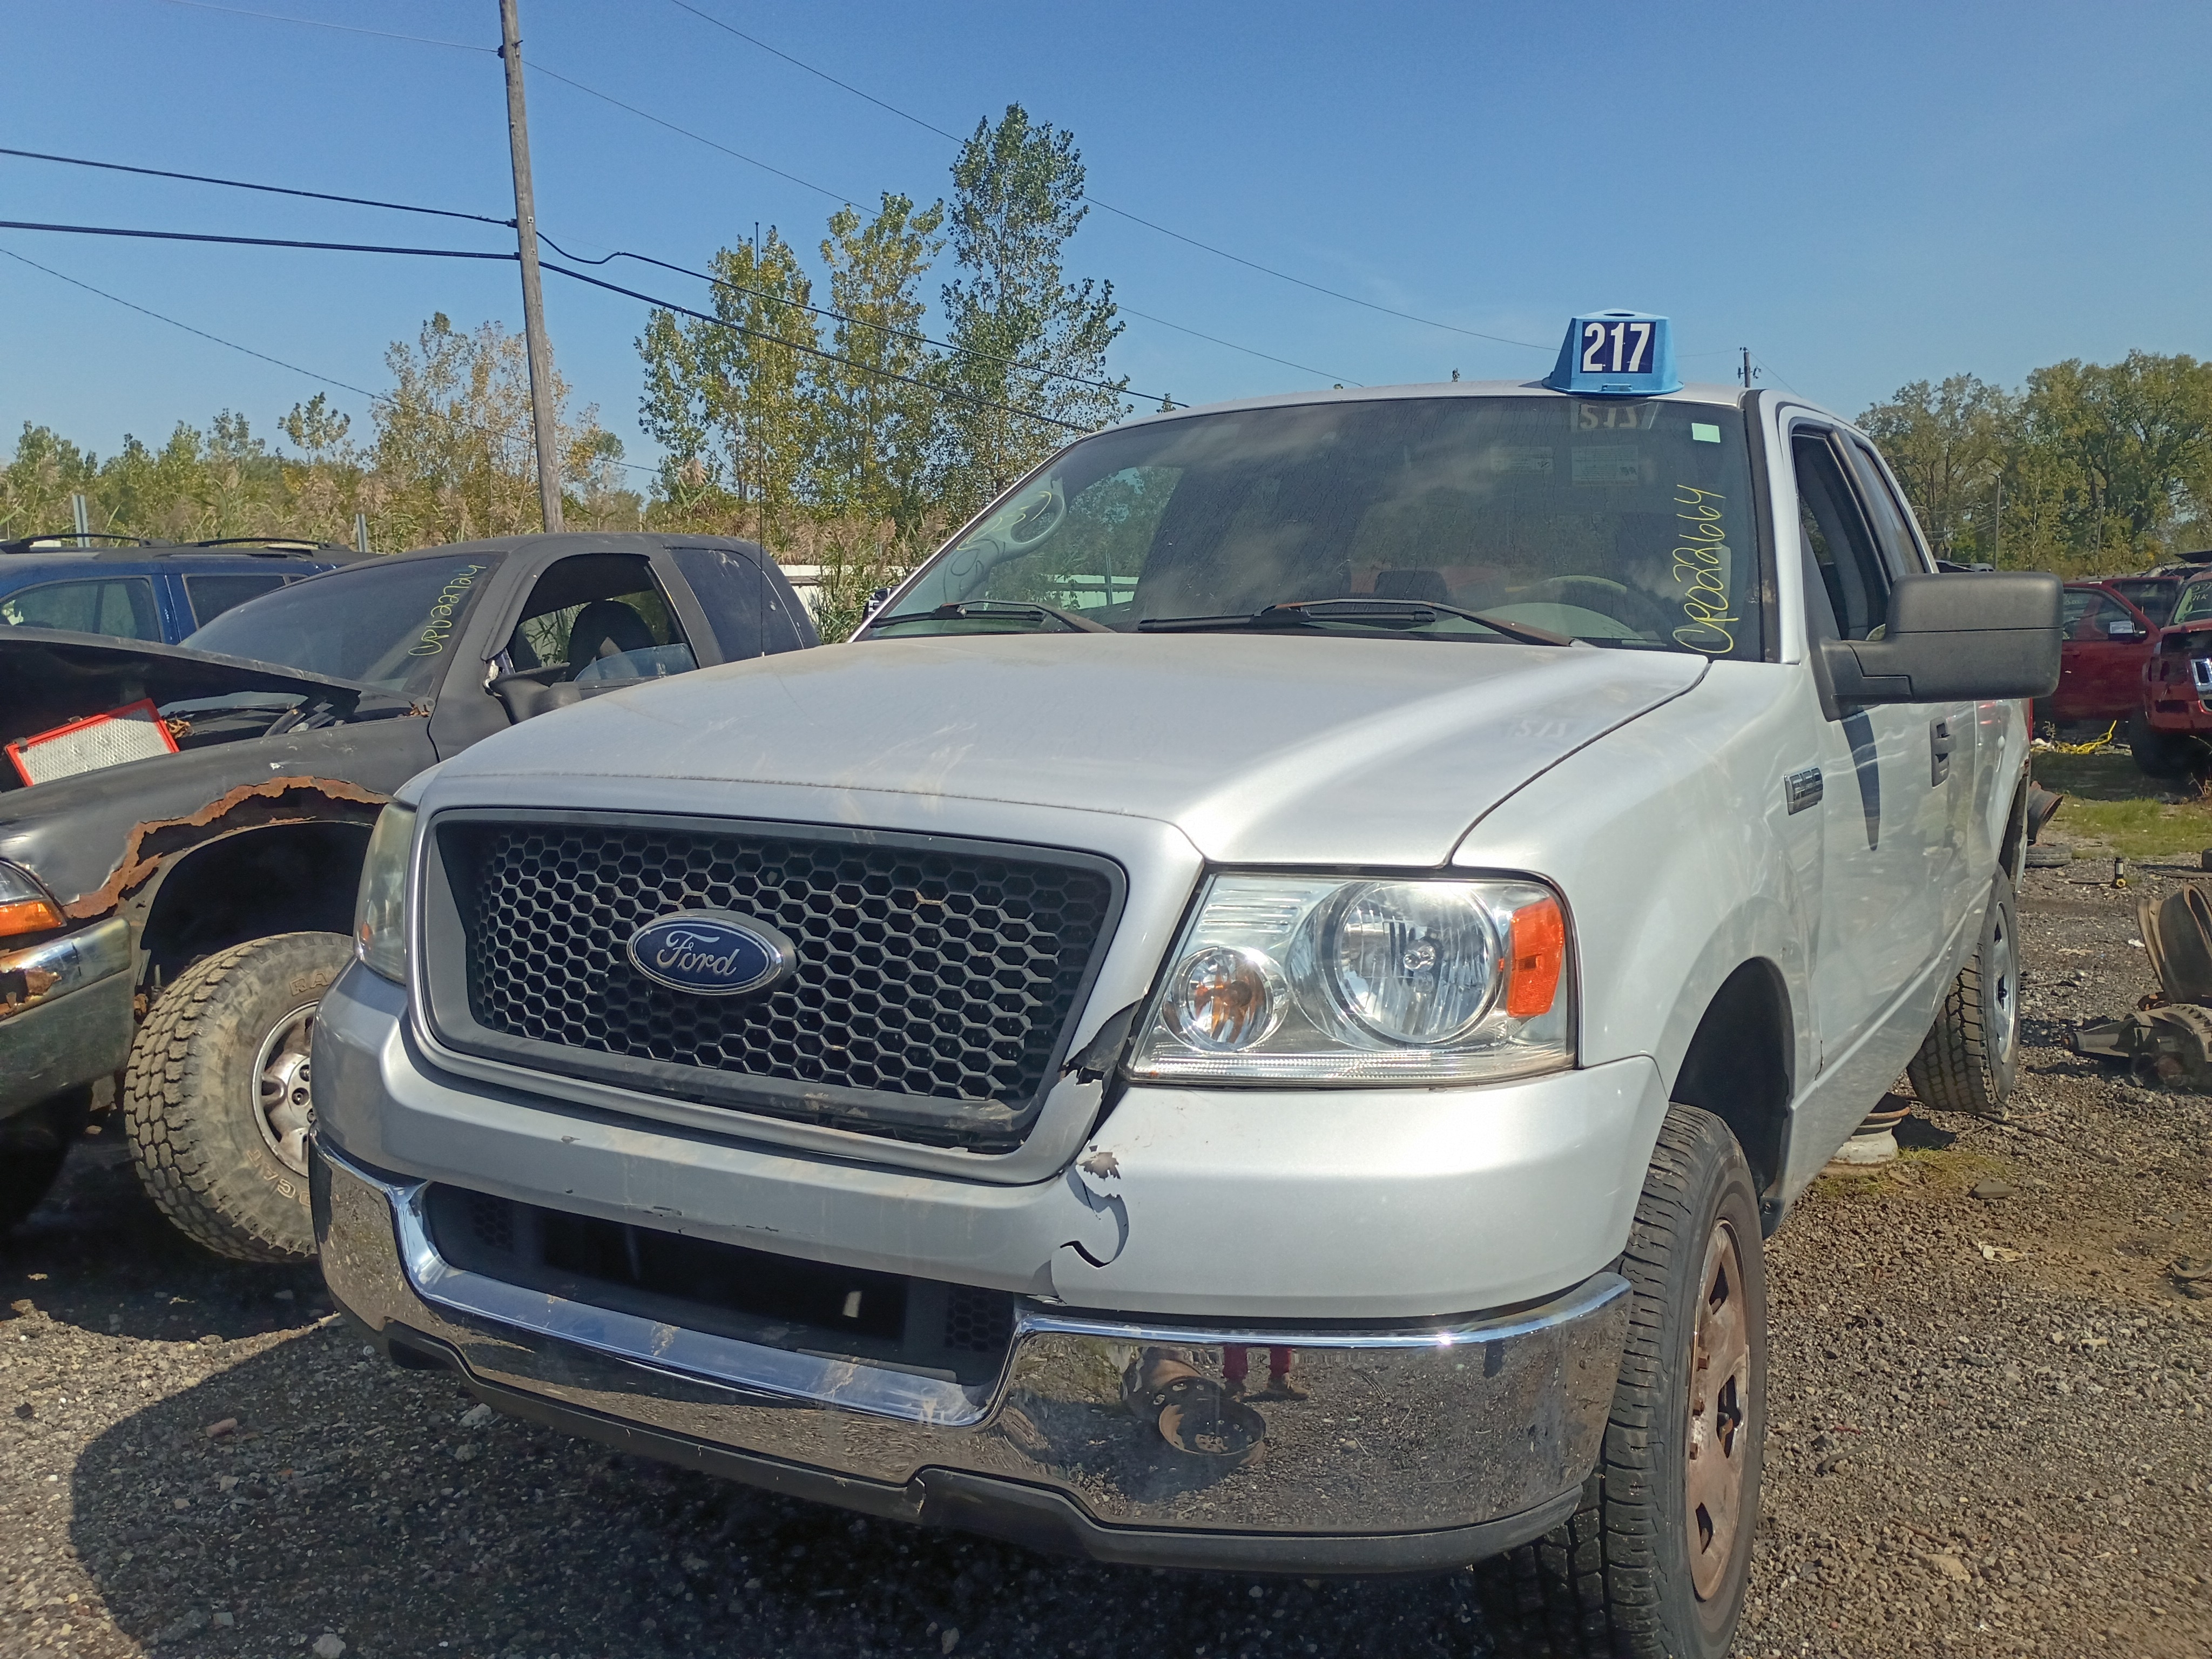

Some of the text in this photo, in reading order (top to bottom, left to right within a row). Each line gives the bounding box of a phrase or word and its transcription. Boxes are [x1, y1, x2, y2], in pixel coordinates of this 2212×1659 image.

[1583, 323, 1650, 372] 217
[1673, 484, 1739, 653] CP022664
[656, 930, 740, 977] Ford
[289, 972, 333, 996] RA
